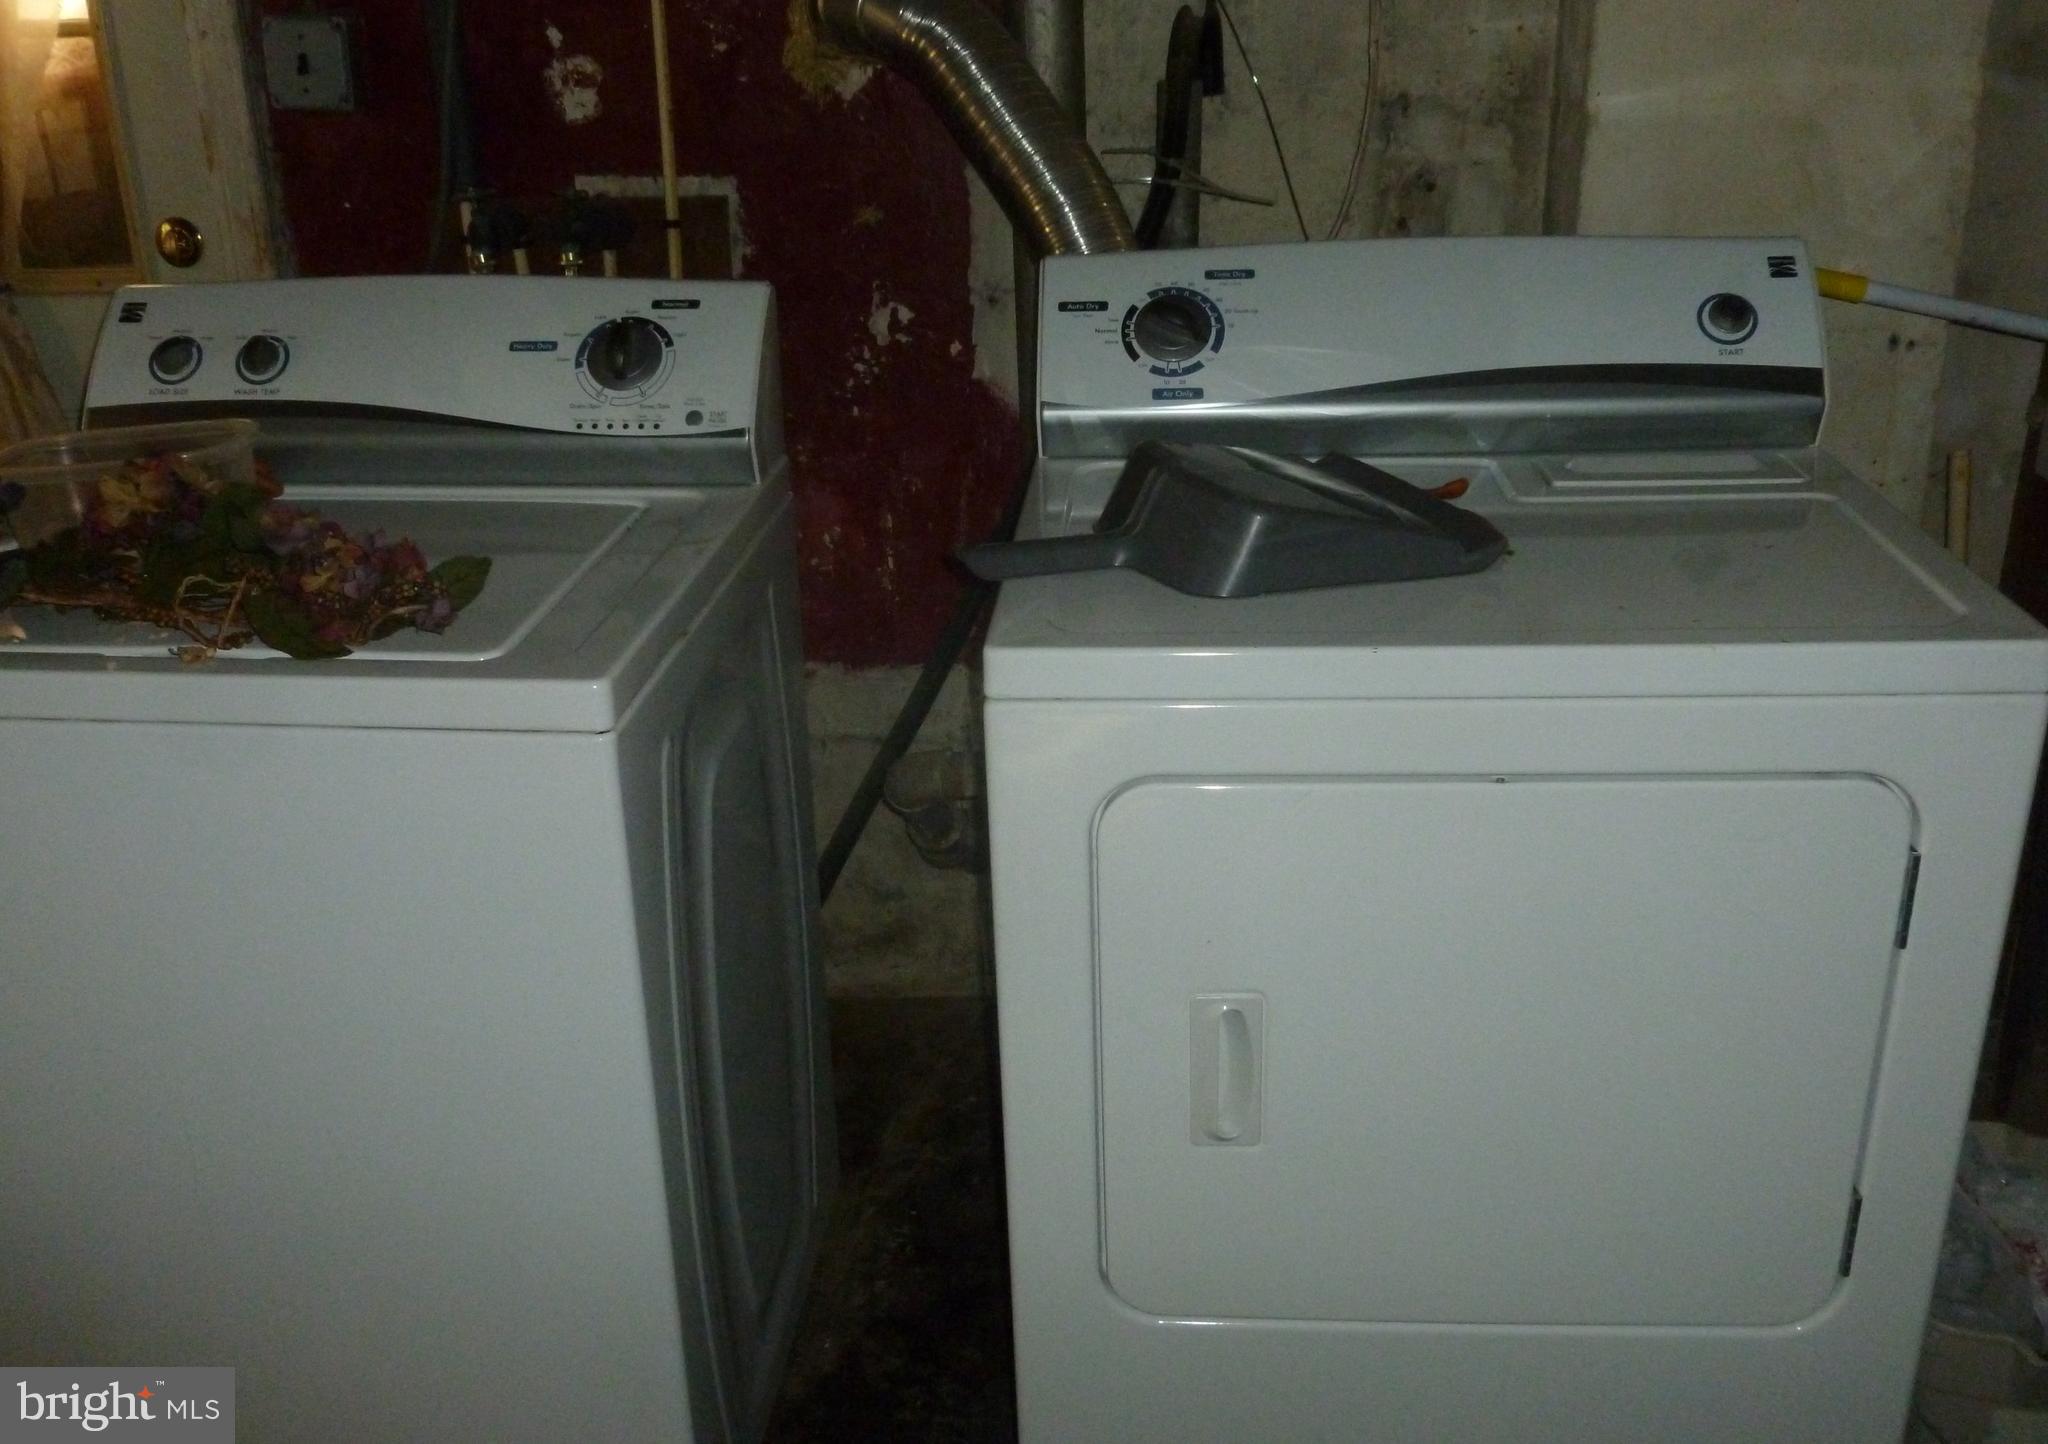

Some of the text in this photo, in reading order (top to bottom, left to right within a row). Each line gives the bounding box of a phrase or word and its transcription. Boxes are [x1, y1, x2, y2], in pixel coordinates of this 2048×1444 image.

[1232, 271, 1247, 279] Dry
[1086, 303, 1100, 311] Dry
[1719, 348, 1744, 356] START
[148, 388, 171, 396] LOAD
[233, 388, 281, 396] WASH TEMP
[1162, 389, 1194, 398] Air Only
